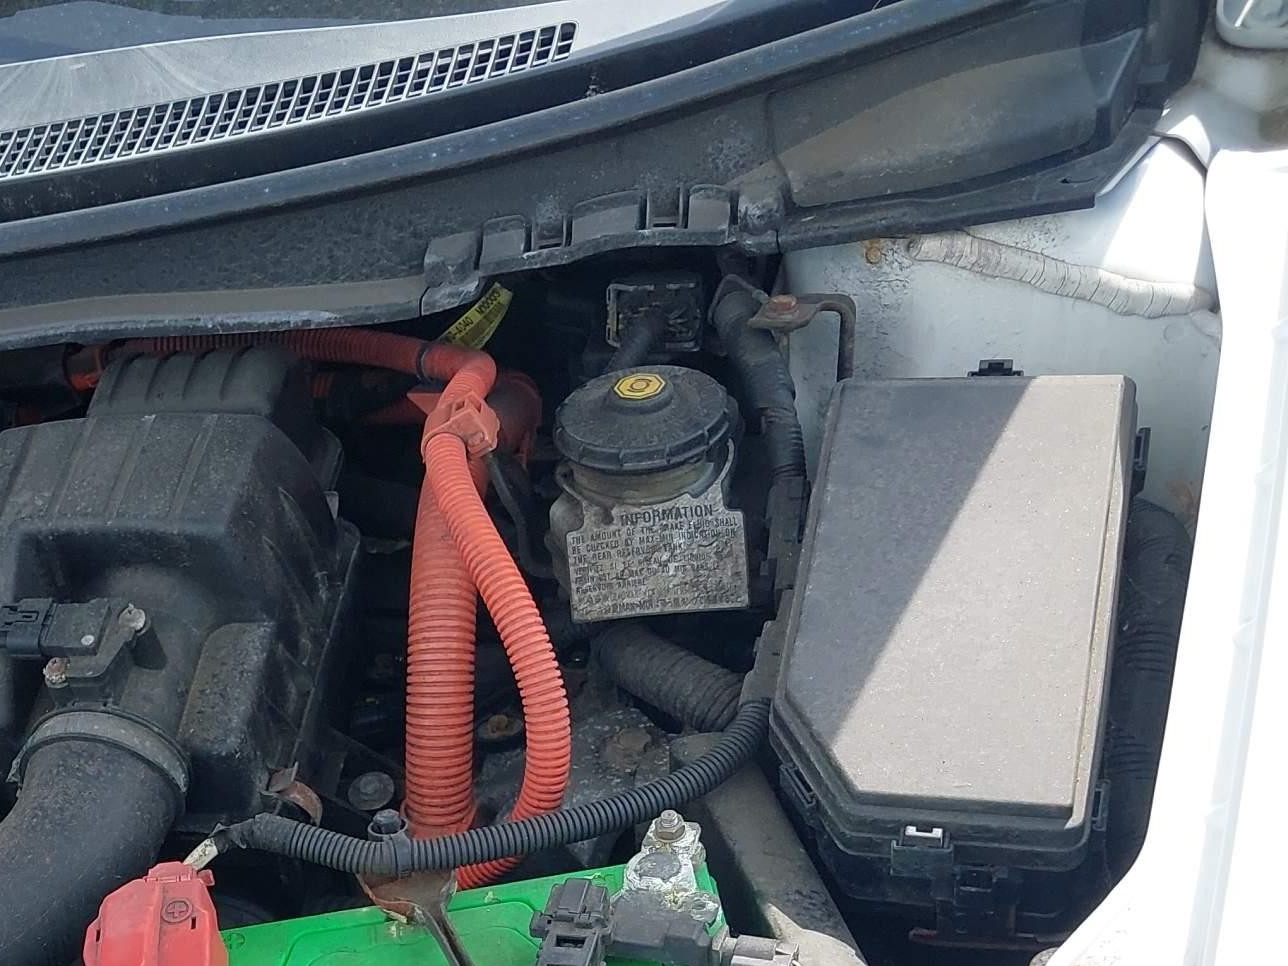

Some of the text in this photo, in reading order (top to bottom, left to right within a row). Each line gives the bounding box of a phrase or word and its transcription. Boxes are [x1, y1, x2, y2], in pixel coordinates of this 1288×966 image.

[619, 505, 713, 526] INFORMATION
[590, 531, 621, 541] AMOUNT
[626, 529, 636, 537] OF
[714, 516, 738, 527] SHALL
